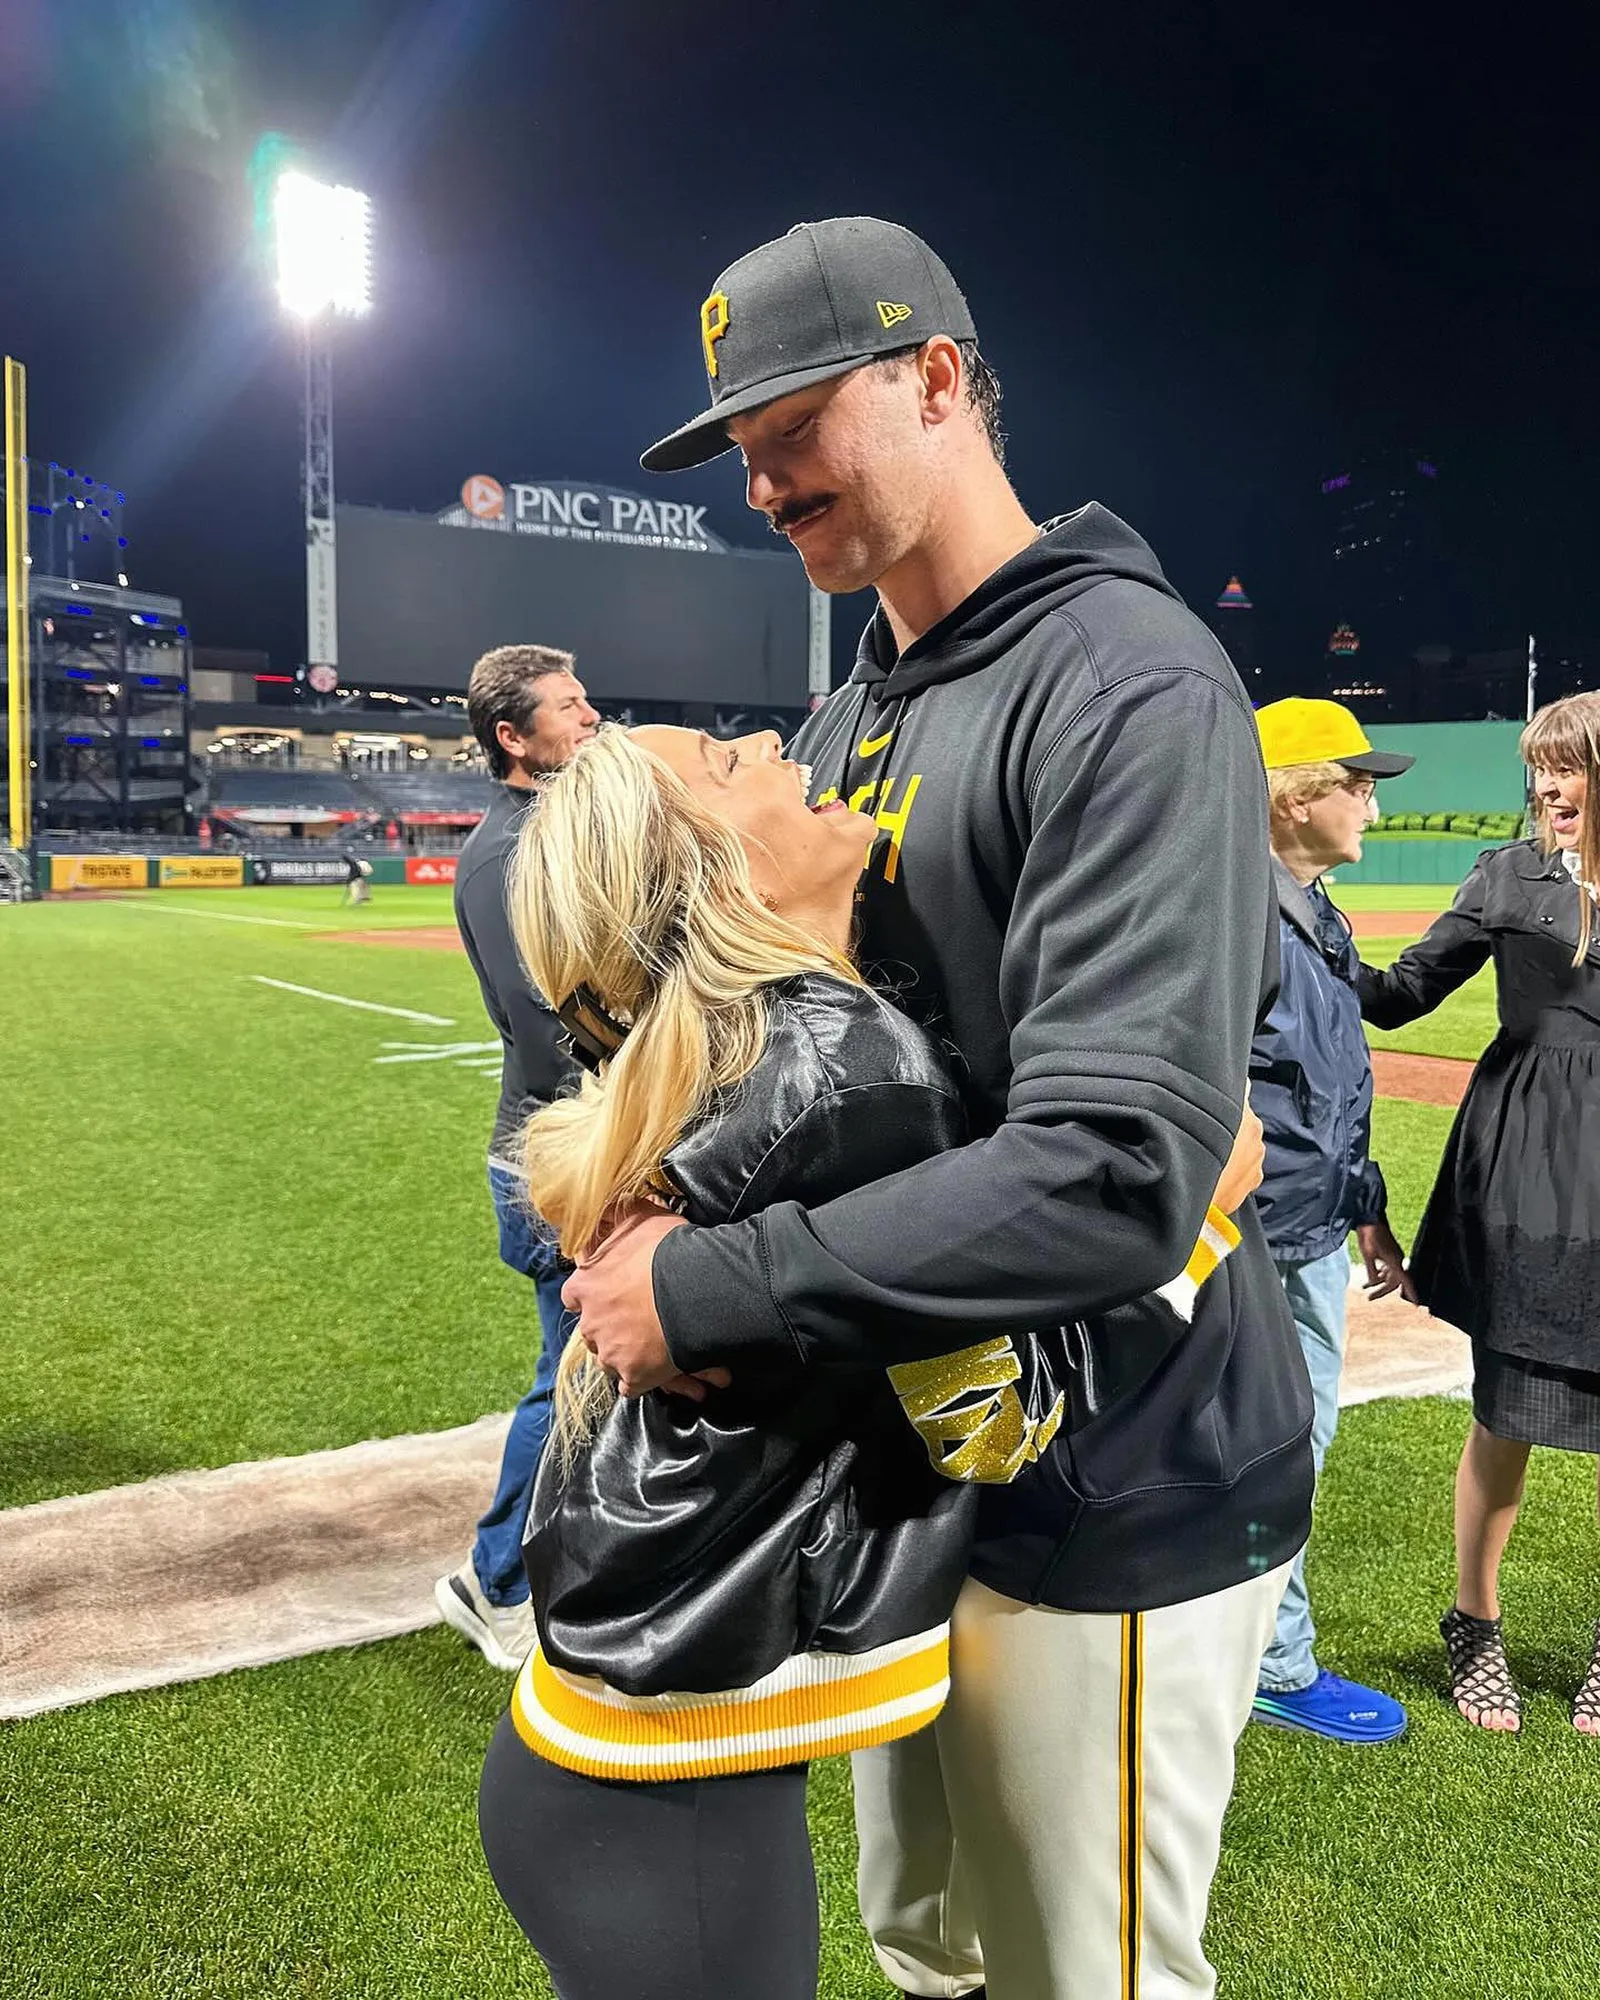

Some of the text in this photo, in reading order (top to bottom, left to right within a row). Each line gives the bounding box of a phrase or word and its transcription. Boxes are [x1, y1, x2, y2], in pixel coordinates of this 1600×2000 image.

[700, 289, 730, 378] P
[510, 483, 708, 540] PNC PARK
[516, 521, 549, 536] HOME
[551, 525, 569, 538] OF
[571, 528, 591, 541] THE
